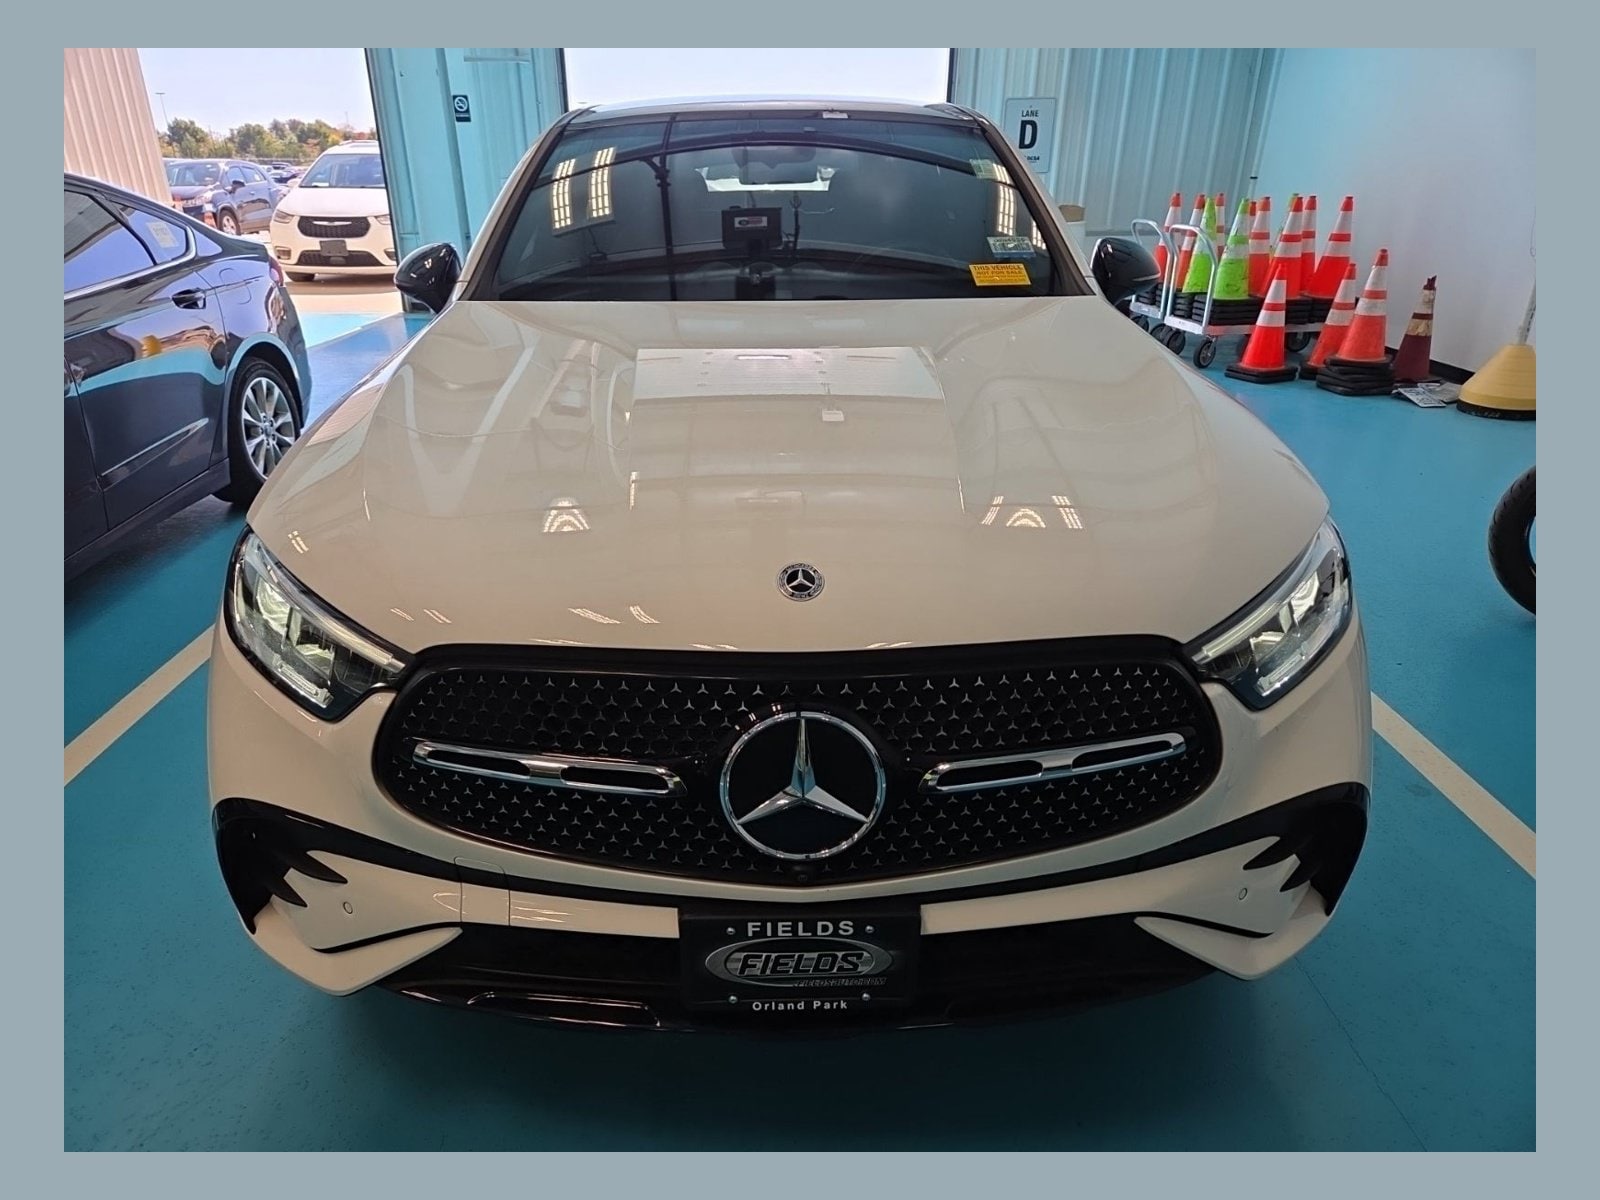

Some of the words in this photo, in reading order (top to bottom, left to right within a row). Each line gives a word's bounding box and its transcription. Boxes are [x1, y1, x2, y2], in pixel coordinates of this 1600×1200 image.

[1021, 109, 1040, 118] LANE
[1018, 119, 1038, 150] D
[747, 921, 854, 937] FIELDS
[738, 952, 864, 976] FIELDS
[752, 1001, 805, 1011] Orland
[812, 1000, 848, 1010] Park
